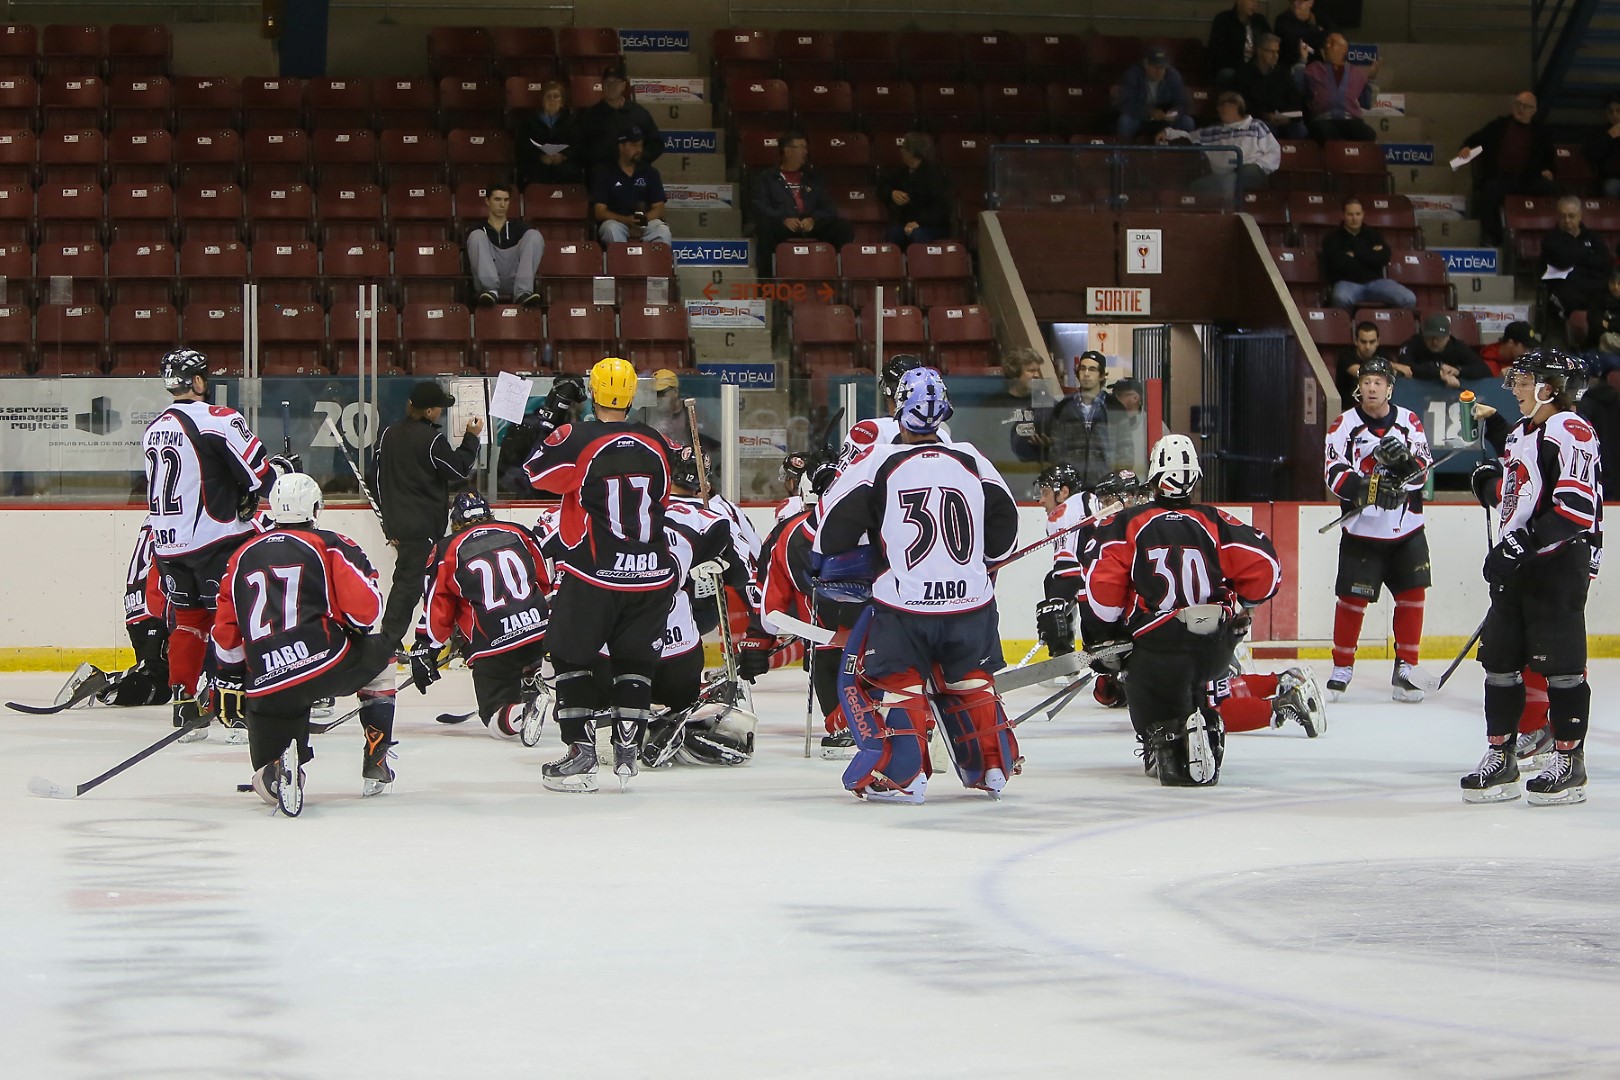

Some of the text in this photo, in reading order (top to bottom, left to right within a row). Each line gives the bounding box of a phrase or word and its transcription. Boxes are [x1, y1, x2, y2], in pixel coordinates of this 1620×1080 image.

[658, 35, 689, 47] D'EAU
[683, 136, 715, 149] D'EAU
[1403, 149, 1433, 161] D'EAU
[673, 246, 747, 260] DÉGÂT D'EAU
[1464, 255, 1496, 269] D'EAU
[1095, 289, 1142, 312] SORTIE
[725, 332, 735, 347] C
[738, 369, 774, 383] D'EAU
[6, 406, 69, 414] services
[611, 397, 618, 406] 4
[310, 401, 380, 450] 20
[147, 429, 184, 447] BERTRAND
[1569, 446, 1593, 483] 17
[145, 445, 183, 516] 22
[602, 474, 654, 544] 17
[154, 527, 176, 545] ABO
[898, 486, 975, 572] 30
[613, 551, 659, 572] ZABO
[465, 548, 533, 614] 20
[596, 569, 640, 579] COMBAT
[1146, 545, 1213, 613] 30
[923, 579, 967, 600] ZABO
[243, 563, 304, 644] 27
[948, 596, 981, 605] HOCKEY
[500, 607, 541, 634] ZABO
[261, 640, 310, 673] ZABO
[214, 677, 243, 690] CM
[844, 685, 872, 741] Reebok
